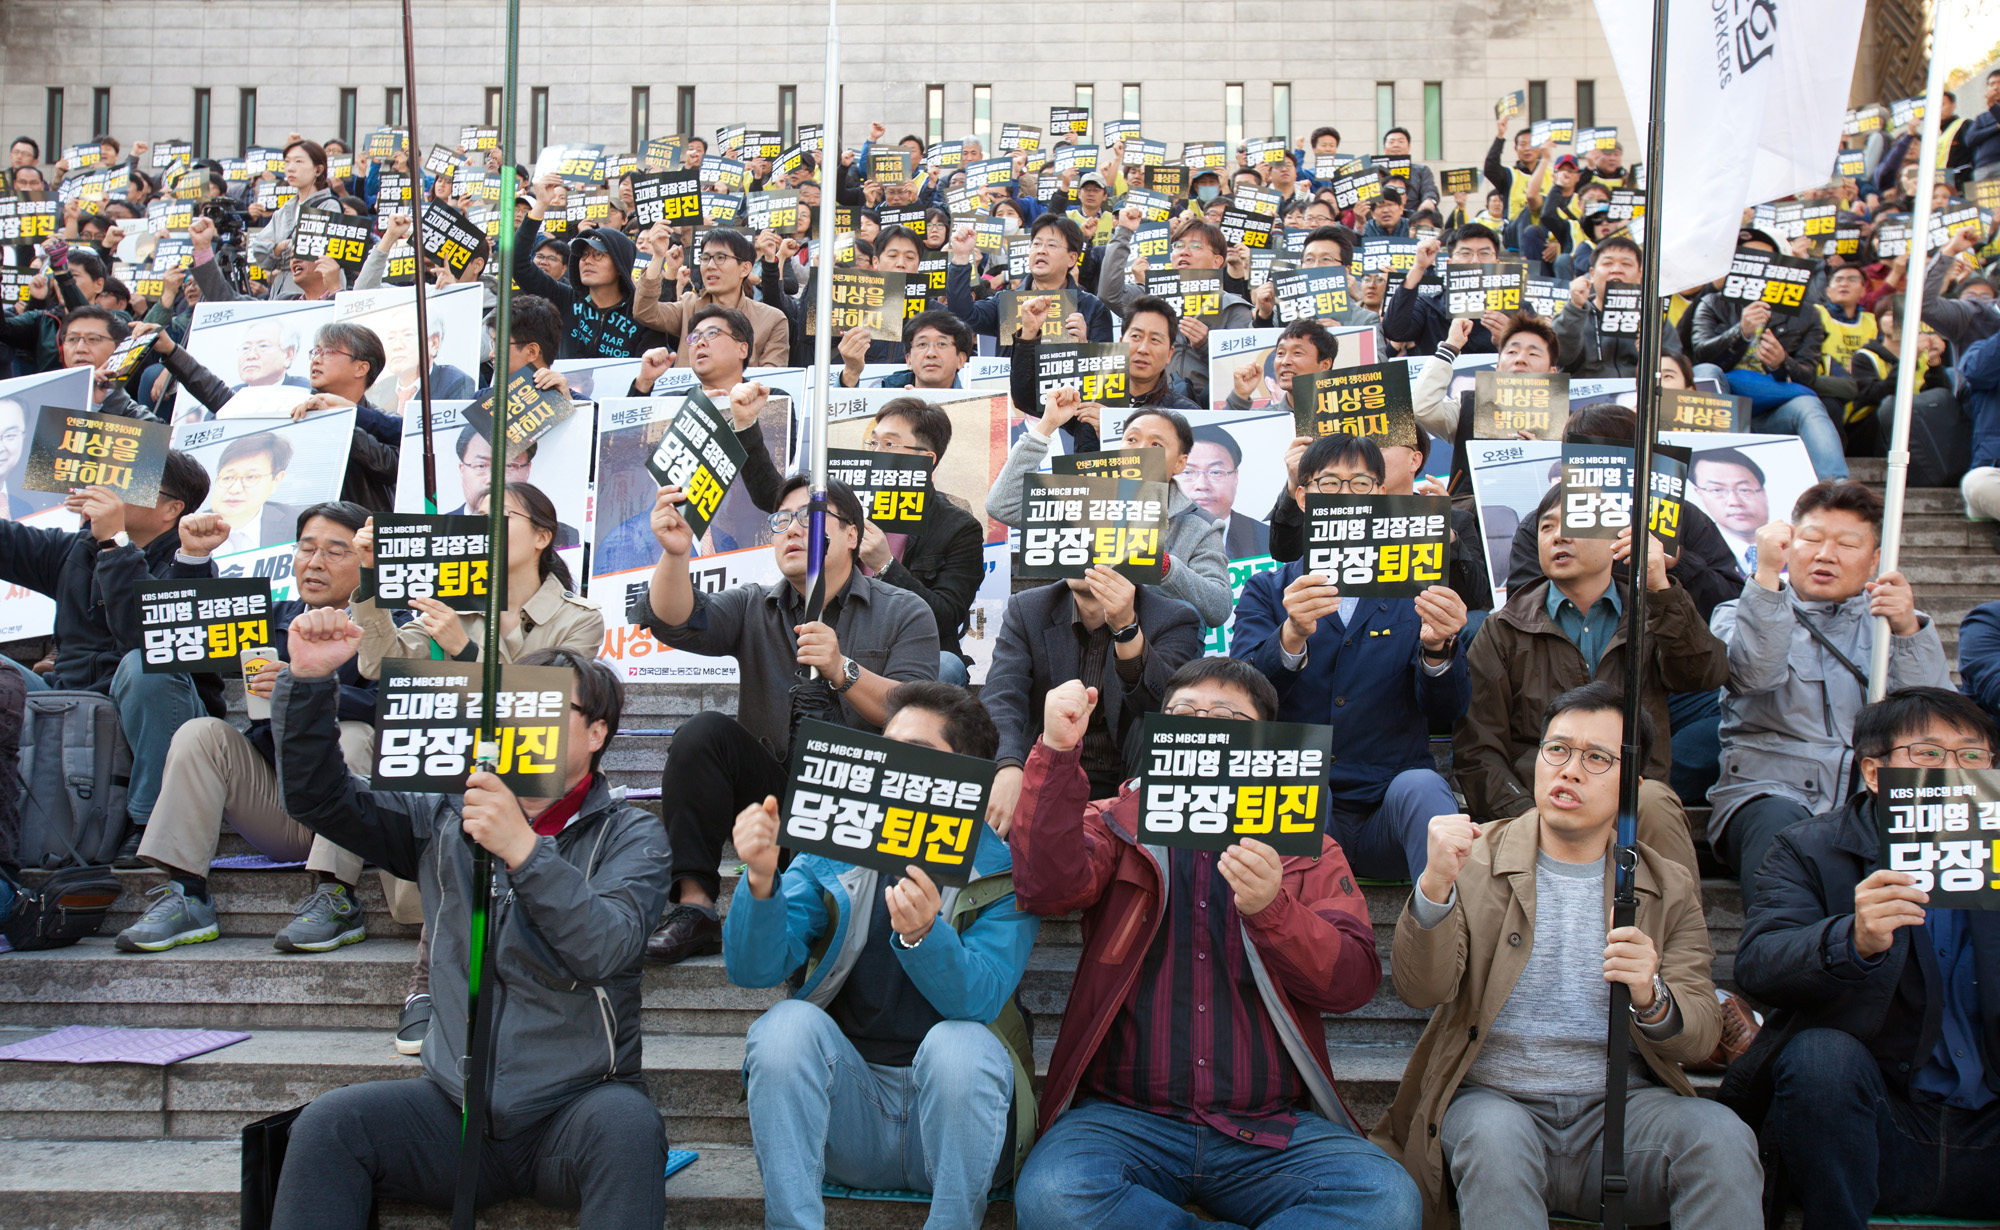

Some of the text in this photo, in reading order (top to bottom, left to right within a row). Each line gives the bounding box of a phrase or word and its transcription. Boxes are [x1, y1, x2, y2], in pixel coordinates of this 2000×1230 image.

[875, 161, 902, 171] 세상을
[875, 173, 903, 182] 밝히자
[1152, 174, 1180, 183] 세상을
[635, 187, 658, 201] 고대영
[660, 180, 697, 196] 김장겸은
[17, 201, 56, 214] 김장겸은
[881, 211, 925, 223] 고대영 김장겸은
[1222, 216, 1272, 231] 고대영 김장겸은
[299, 220, 367, 239] 고대영 김장겸은
[425, 212, 479, 250] 고대영 김장겸은
[1136, 228, 1168, 241] 김장겸은
[1364, 245, 1387, 254] 고대영
[1732, 260, 1811, 283] 고대영 김장겸은
[1148, 279, 1220, 296] 고대영 김장겸은
[1277, 275, 1345, 298] 고대영 김장겸은
[1449, 274, 1520, 290] 고대영 김장겸은
[832, 286, 884, 306] 세상을
[1605, 296, 1636, 309] 고대영
[344, 298, 376, 315] 고영주
[201, 309, 234, 324] 고영주
[831, 310, 883, 329] 밝히자
[602, 333, 623, 346] MAR
[1221, 335, 1257, 351] 최기화
[599, 344, 629, 358] SHOP
[1039, 355, 1125, 377] 고대영 김장겸은
[656, 374, 692, 386] 오정환
[1316, 372, 1382, 389] 언론개혁 쟁취하여
[1496, 378, 1550, 386] 언론개혁 쟁취하여
[1316, 385, 1385, 414] 세상을
[1495, 388, 1550, 408] 세상을
[1677, 395, 1732, 407] 언론개혁 쟁취하여
[506, 401, 555, 443] 밝히자
[612, 406, 653, 425] 백종문
[1494, 410, 1549, 430] 밝히자
[1673, 406, 1732, 428] 세상을
[67, 417, 141, 436] 언론개혁 쟁취하여
[184, 426, 225, 446] 김장겸
[58, 430, 139, 462] 세상을
[674, 410, 737, 485] 고대영 김장겸은
[1482, 447, 1524, 463] 오정환
[1076, 456, 1140, 470] 언론개혁 쟁취하여
[54, 458, 133, 489] 밝히자
[870, 469, 927, 487] 김장겸은
[1567, 468, 1620, 487] 고대영
[1027, 500, 1161, 522] 고대영 김장겸은
[1313, 508, 1328, 516] KBS
[1310, 515, 1445, 542] 고대영 김장겸은
[378, 538, 427, 558] 고대영
[142, 595, 266, 624] 고대영 김장겸은
[639, 668, 736, 676] 전국언론노동조합 MBC본부
[389, 678, 410, 687] KBS
[383, 693, 459, 720] 고대영
[807, 740, 828, 752] KBS
[1153, 733, 1173, 743] KBS
[1148, 750, 1323, 777] 고대영 김장겸은
[797, 756, 982, 810] 고대영 김장겸은
[1890, 788, 1914, 799] KBS
[1888, 803, 1969, 833] 고대영
